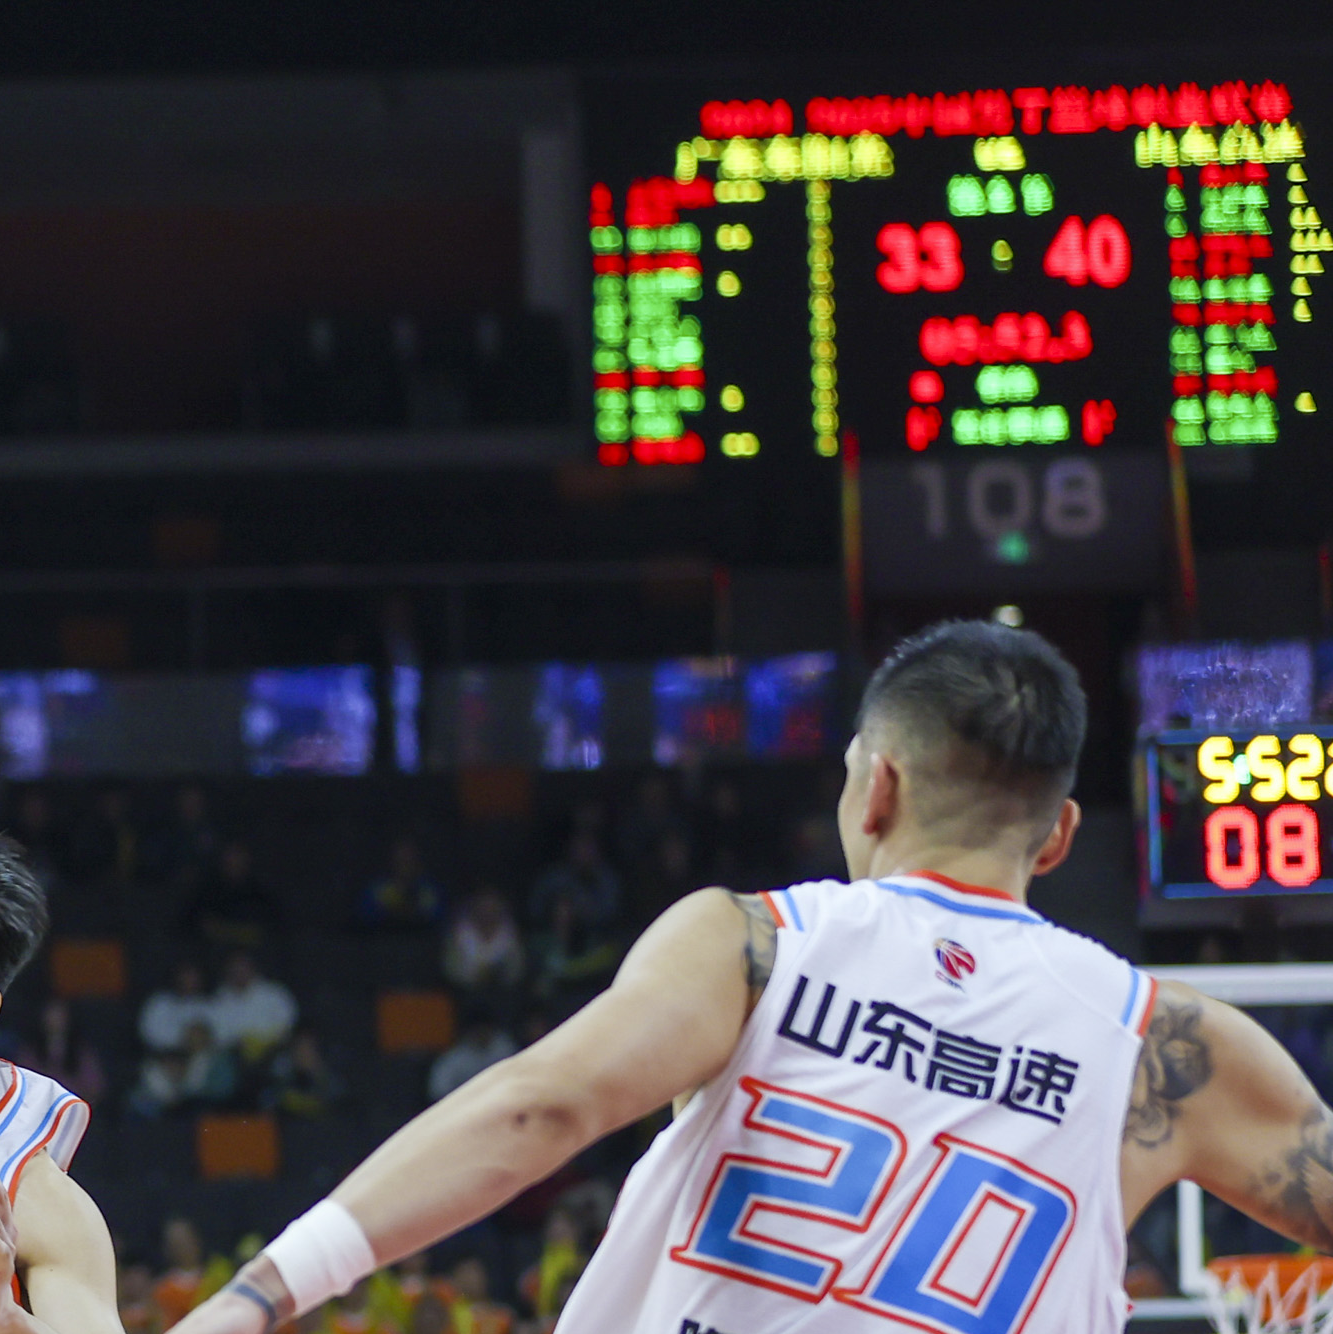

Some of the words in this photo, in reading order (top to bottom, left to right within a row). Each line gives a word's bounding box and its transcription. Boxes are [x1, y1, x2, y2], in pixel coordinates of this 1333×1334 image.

[876, 222, 965, 293] 33
[1043, 215, 1131, 288] 40
[911, 458, 1109, 538] 108
[1204, 805, 1320, 889] 08
[777, 975, 1079, 1125] 山东高速
